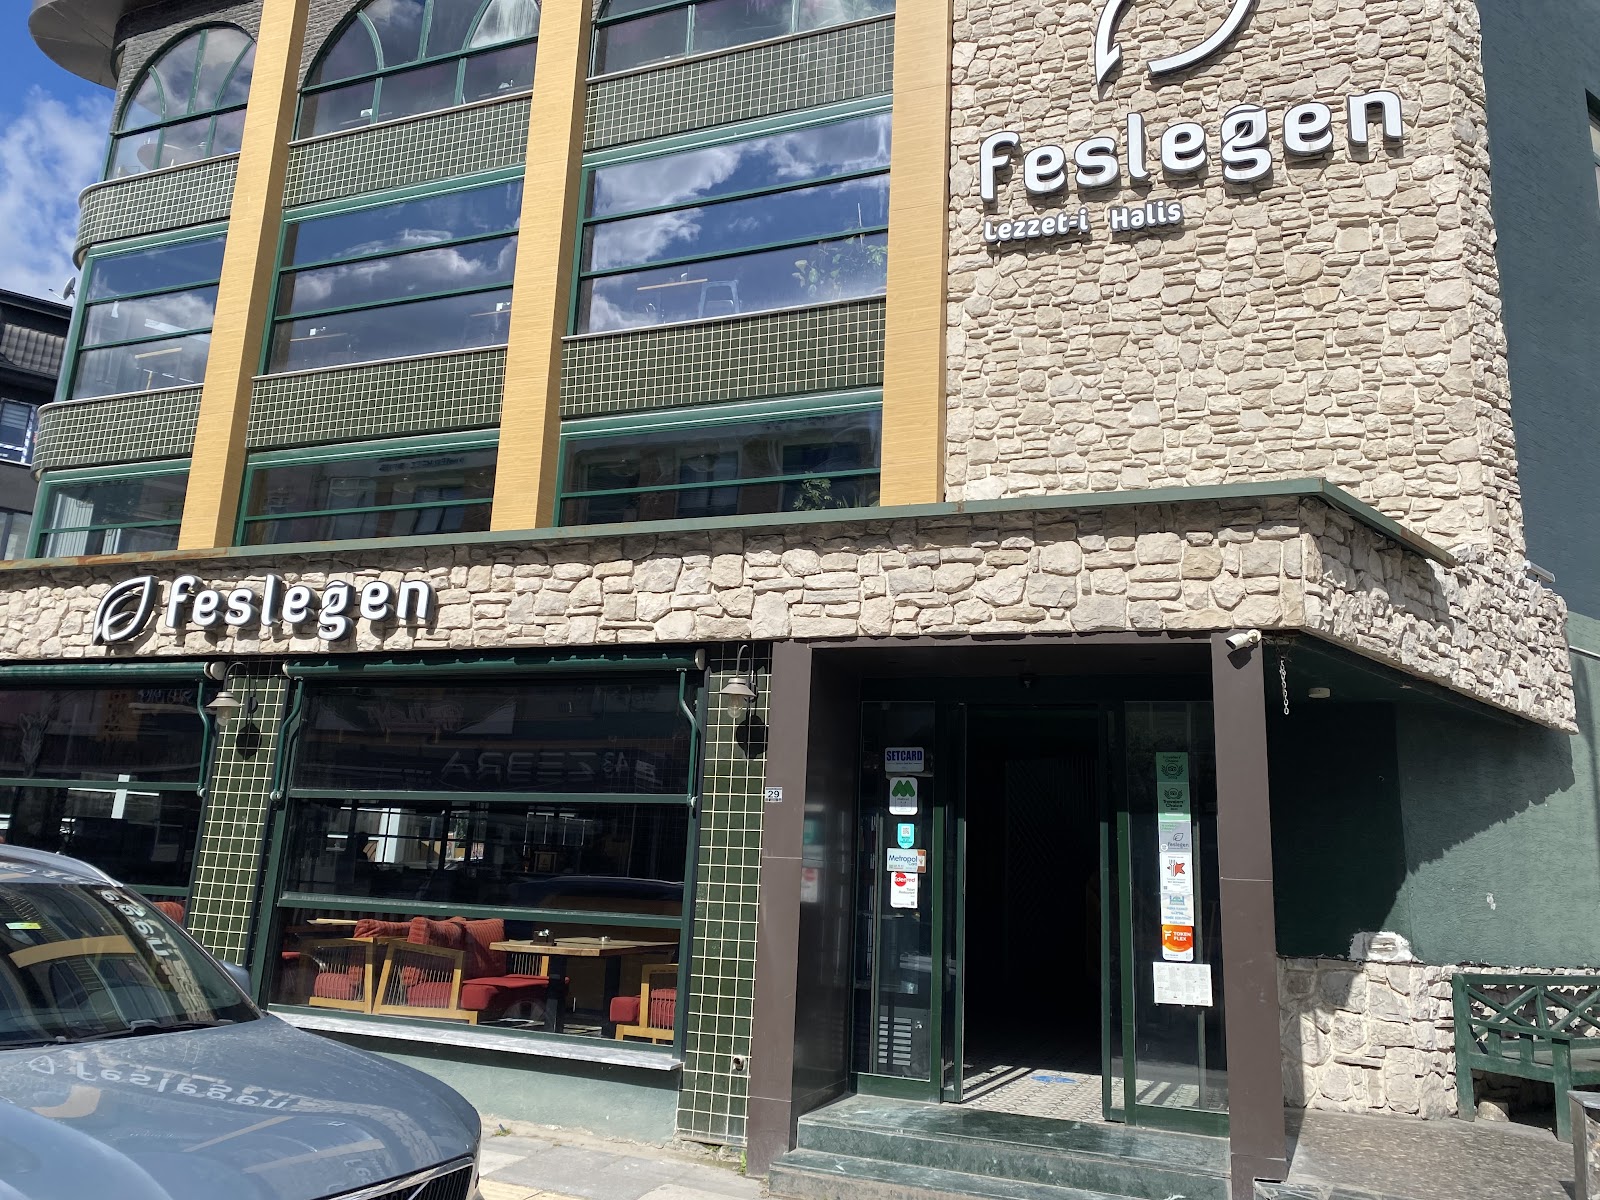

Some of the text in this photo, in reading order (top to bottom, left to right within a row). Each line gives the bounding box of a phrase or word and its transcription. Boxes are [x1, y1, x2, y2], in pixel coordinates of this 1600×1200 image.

[984, 200, 1183, 242] Lezzet-i Halis
[886, 750, 923, 761] SETCARD
[767, 790, 780, 798] 29
[888, 854, 918, 863] Metropol
